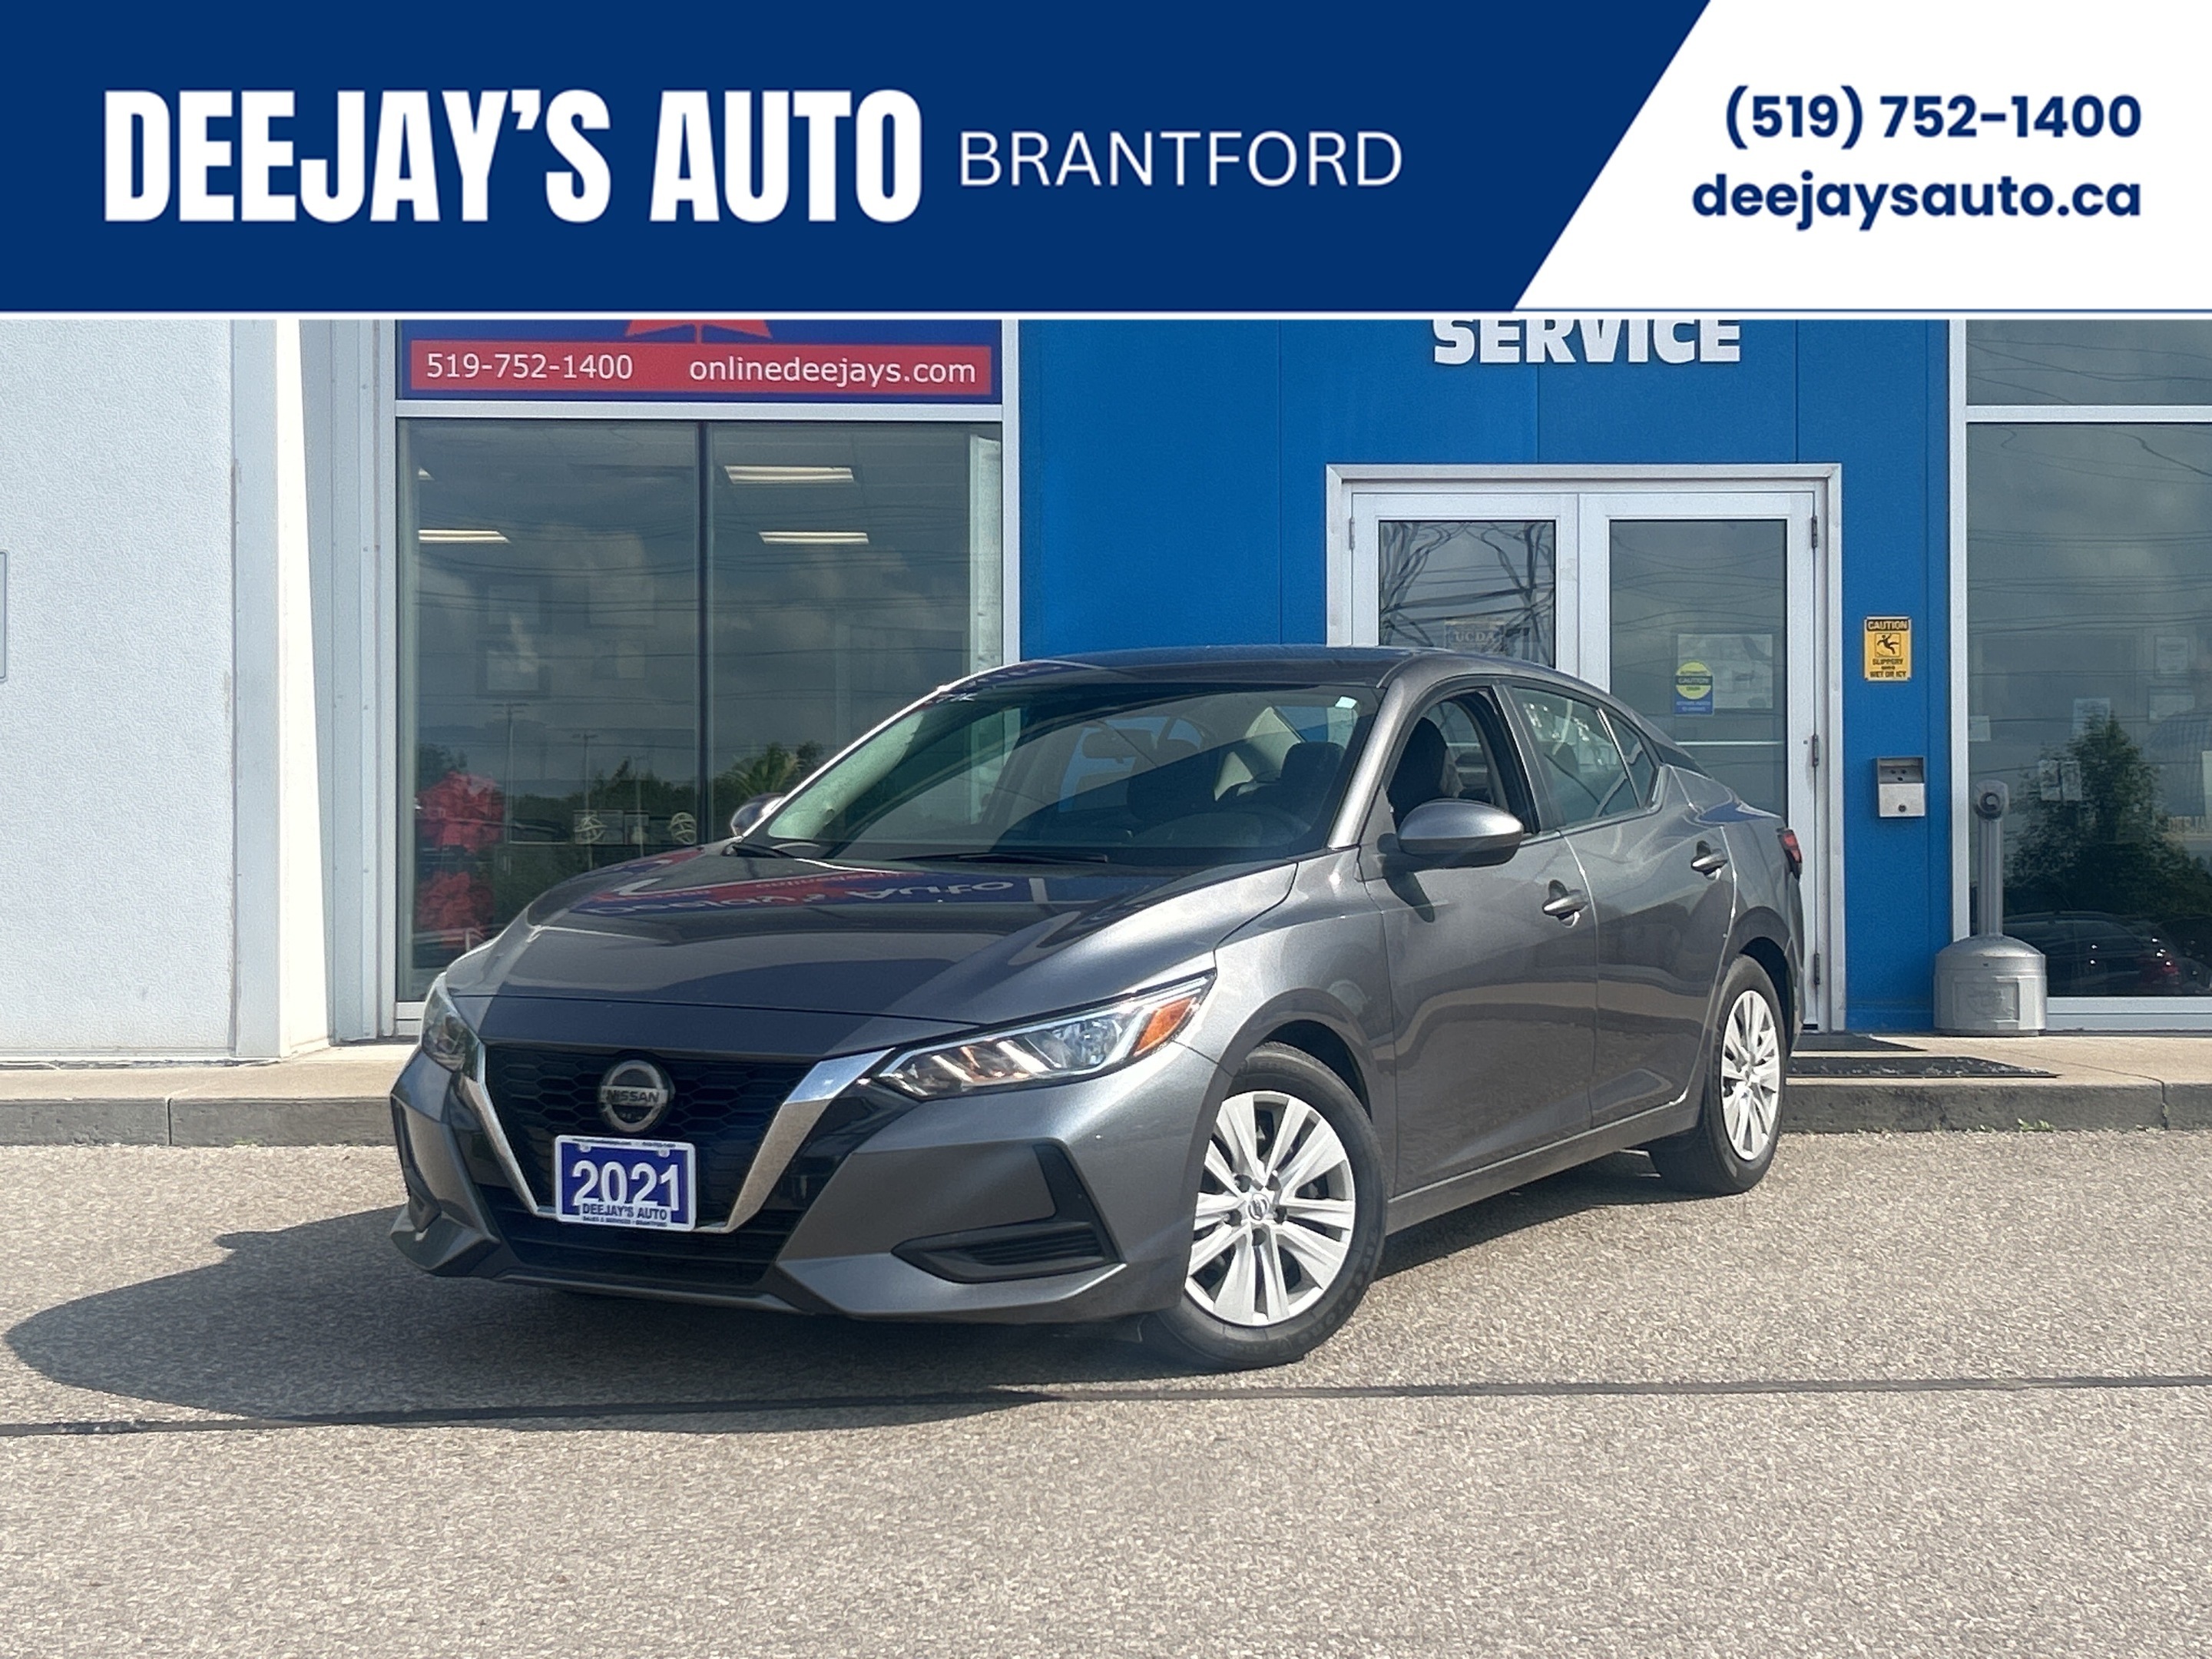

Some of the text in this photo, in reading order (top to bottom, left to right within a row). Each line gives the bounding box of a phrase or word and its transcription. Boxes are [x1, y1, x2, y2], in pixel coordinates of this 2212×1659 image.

[1432, 320, 1741, 365] SERVICE
[426, 353, 976, 389] 519-752-1400 onlinedeejays.com
[1868, 621, 1908, 630] CAUTION
[606, 1090, 659, 1103] NISSAN
[571, 1160, 679, 1211] 2021
[582, 1203, 667, 1220] DEEJAY'S AUTO
